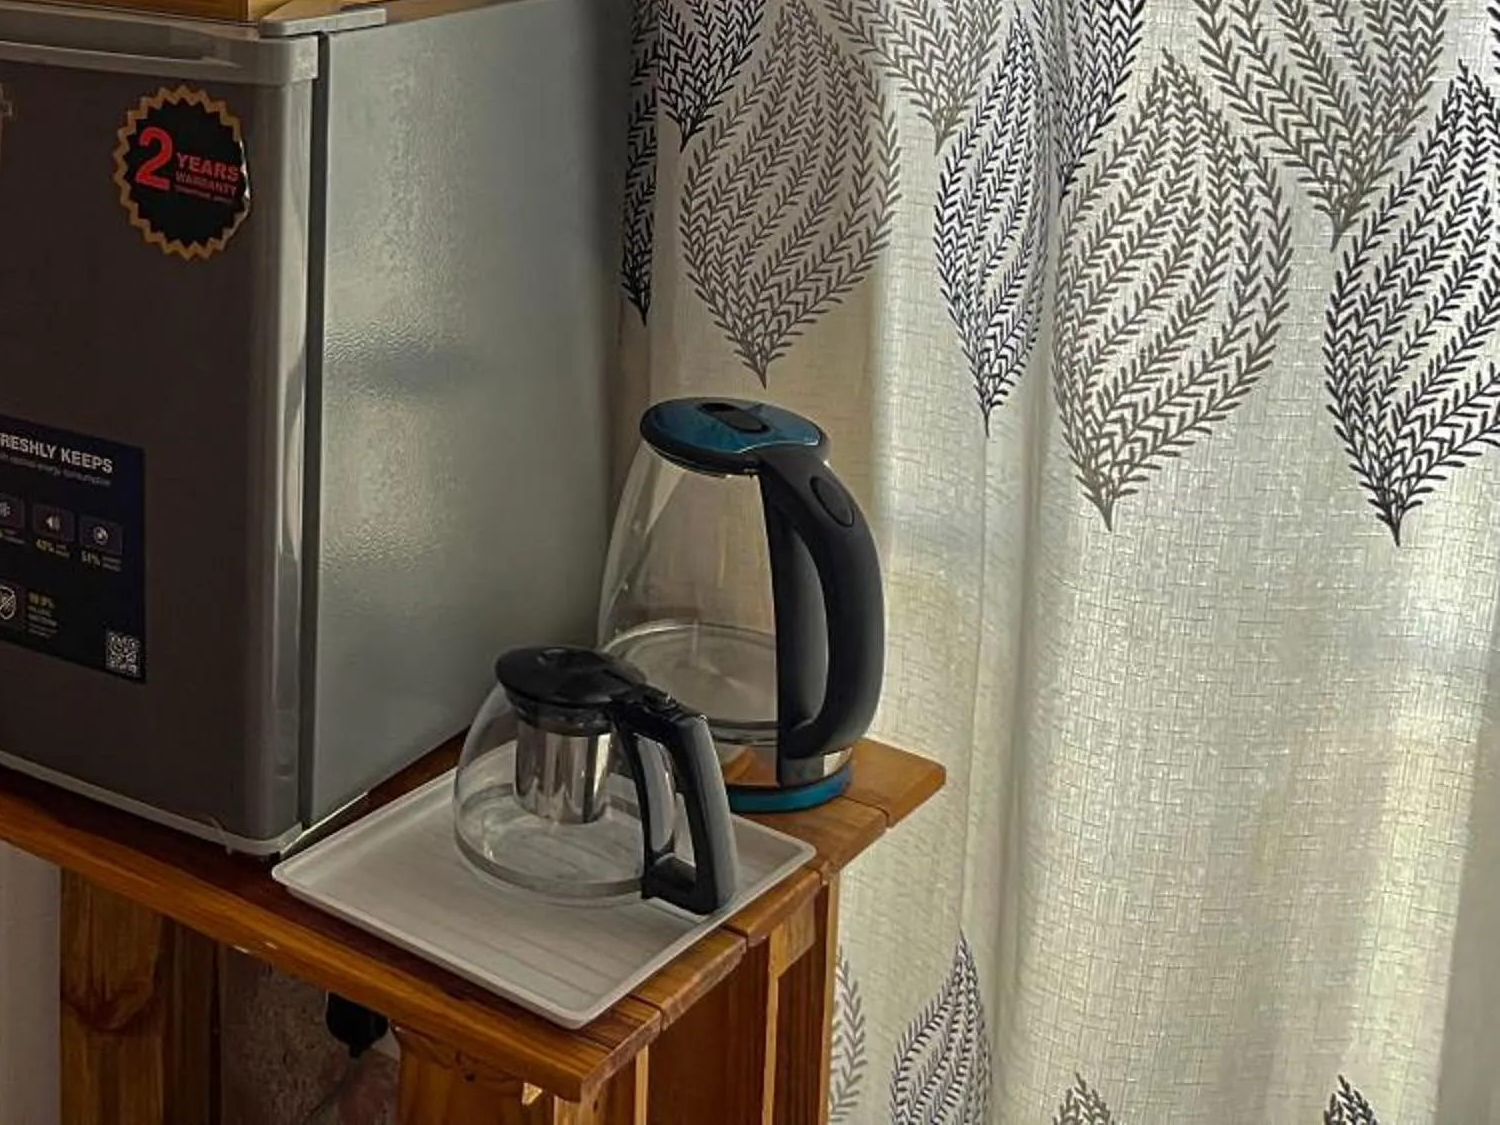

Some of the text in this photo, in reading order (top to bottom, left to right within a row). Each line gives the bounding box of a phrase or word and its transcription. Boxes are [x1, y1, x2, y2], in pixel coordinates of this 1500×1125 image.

[134, 126, 240, 192] 2 YEARS
[59, 446, 114, 475] KEEPS
